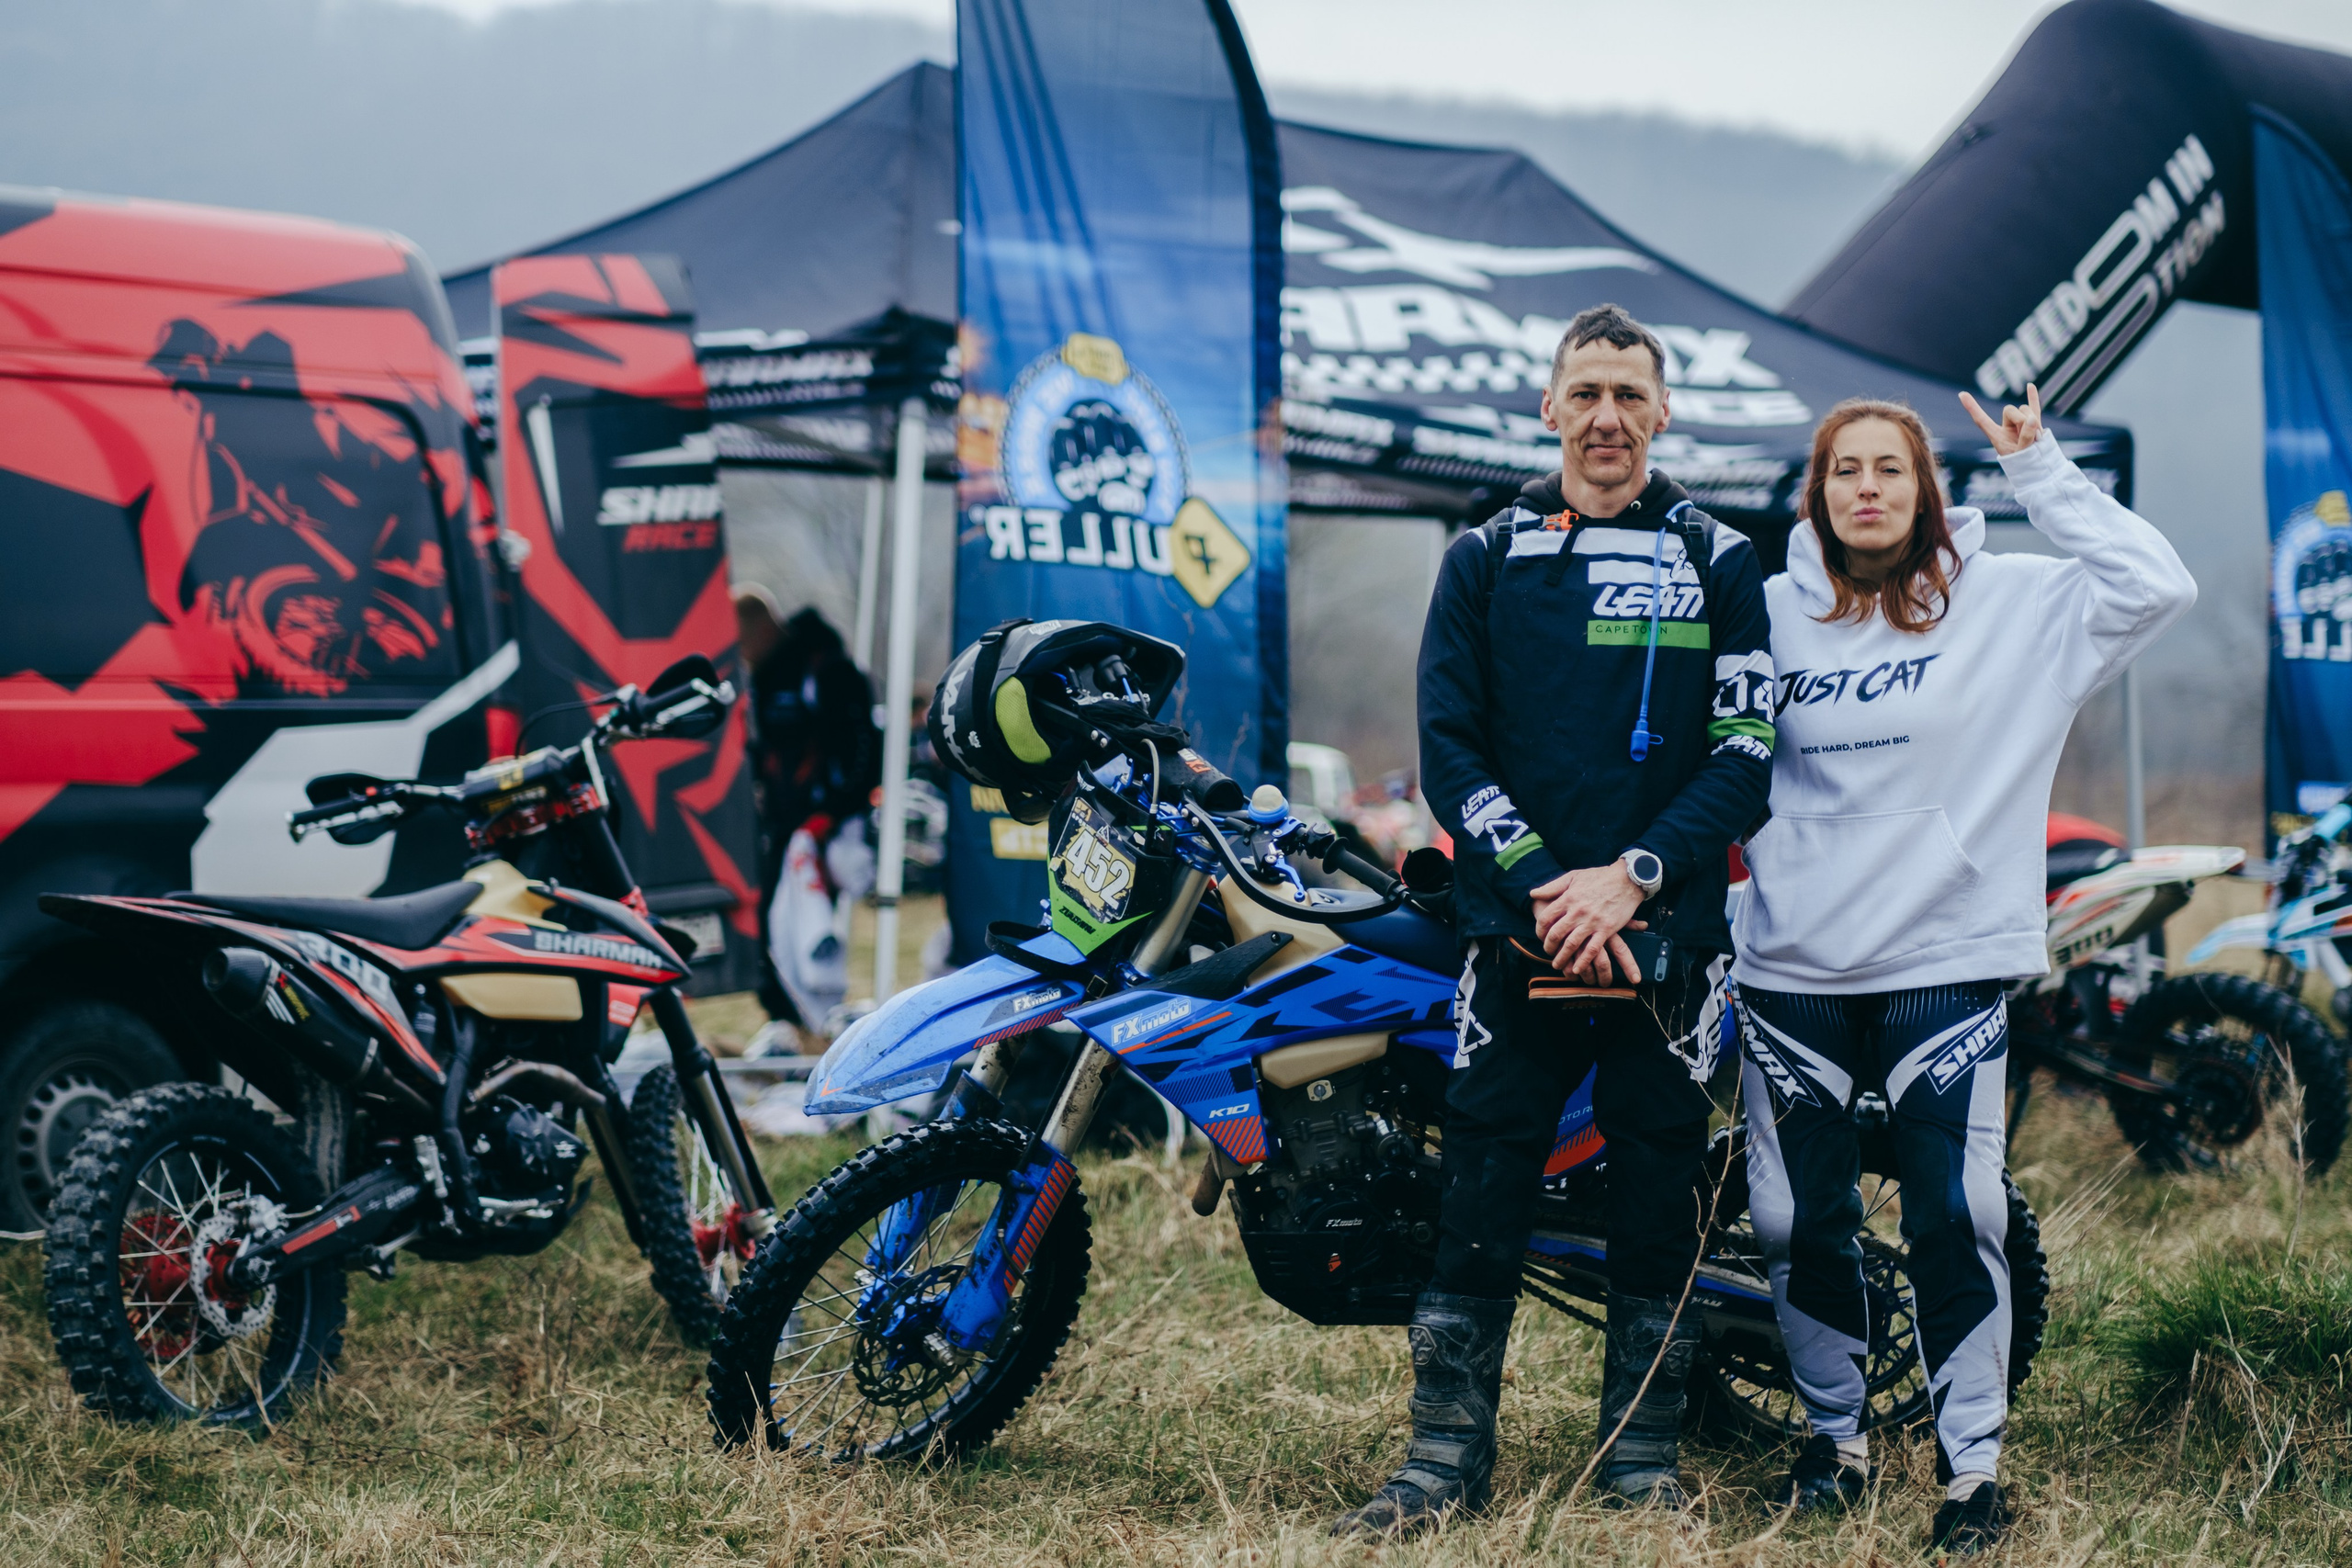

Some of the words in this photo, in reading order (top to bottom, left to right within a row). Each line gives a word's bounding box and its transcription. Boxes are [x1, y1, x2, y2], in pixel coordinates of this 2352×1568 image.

[1774, 669, 1864, 717] JUST
[1856, 652, 1944, 703] CAT
[1800, 747, 1820, 755] RIDE
[1822, 744, 1853, 752] HARD,
[1855, 739, 1891, 750] DREAM
[1893, 735, 1910, 744] BIG
[1066, 829, 1131, 911] 452
[1112, 998, 1192, 1046] FXmoto
[1208, 1103, 1250, 1119] K10
